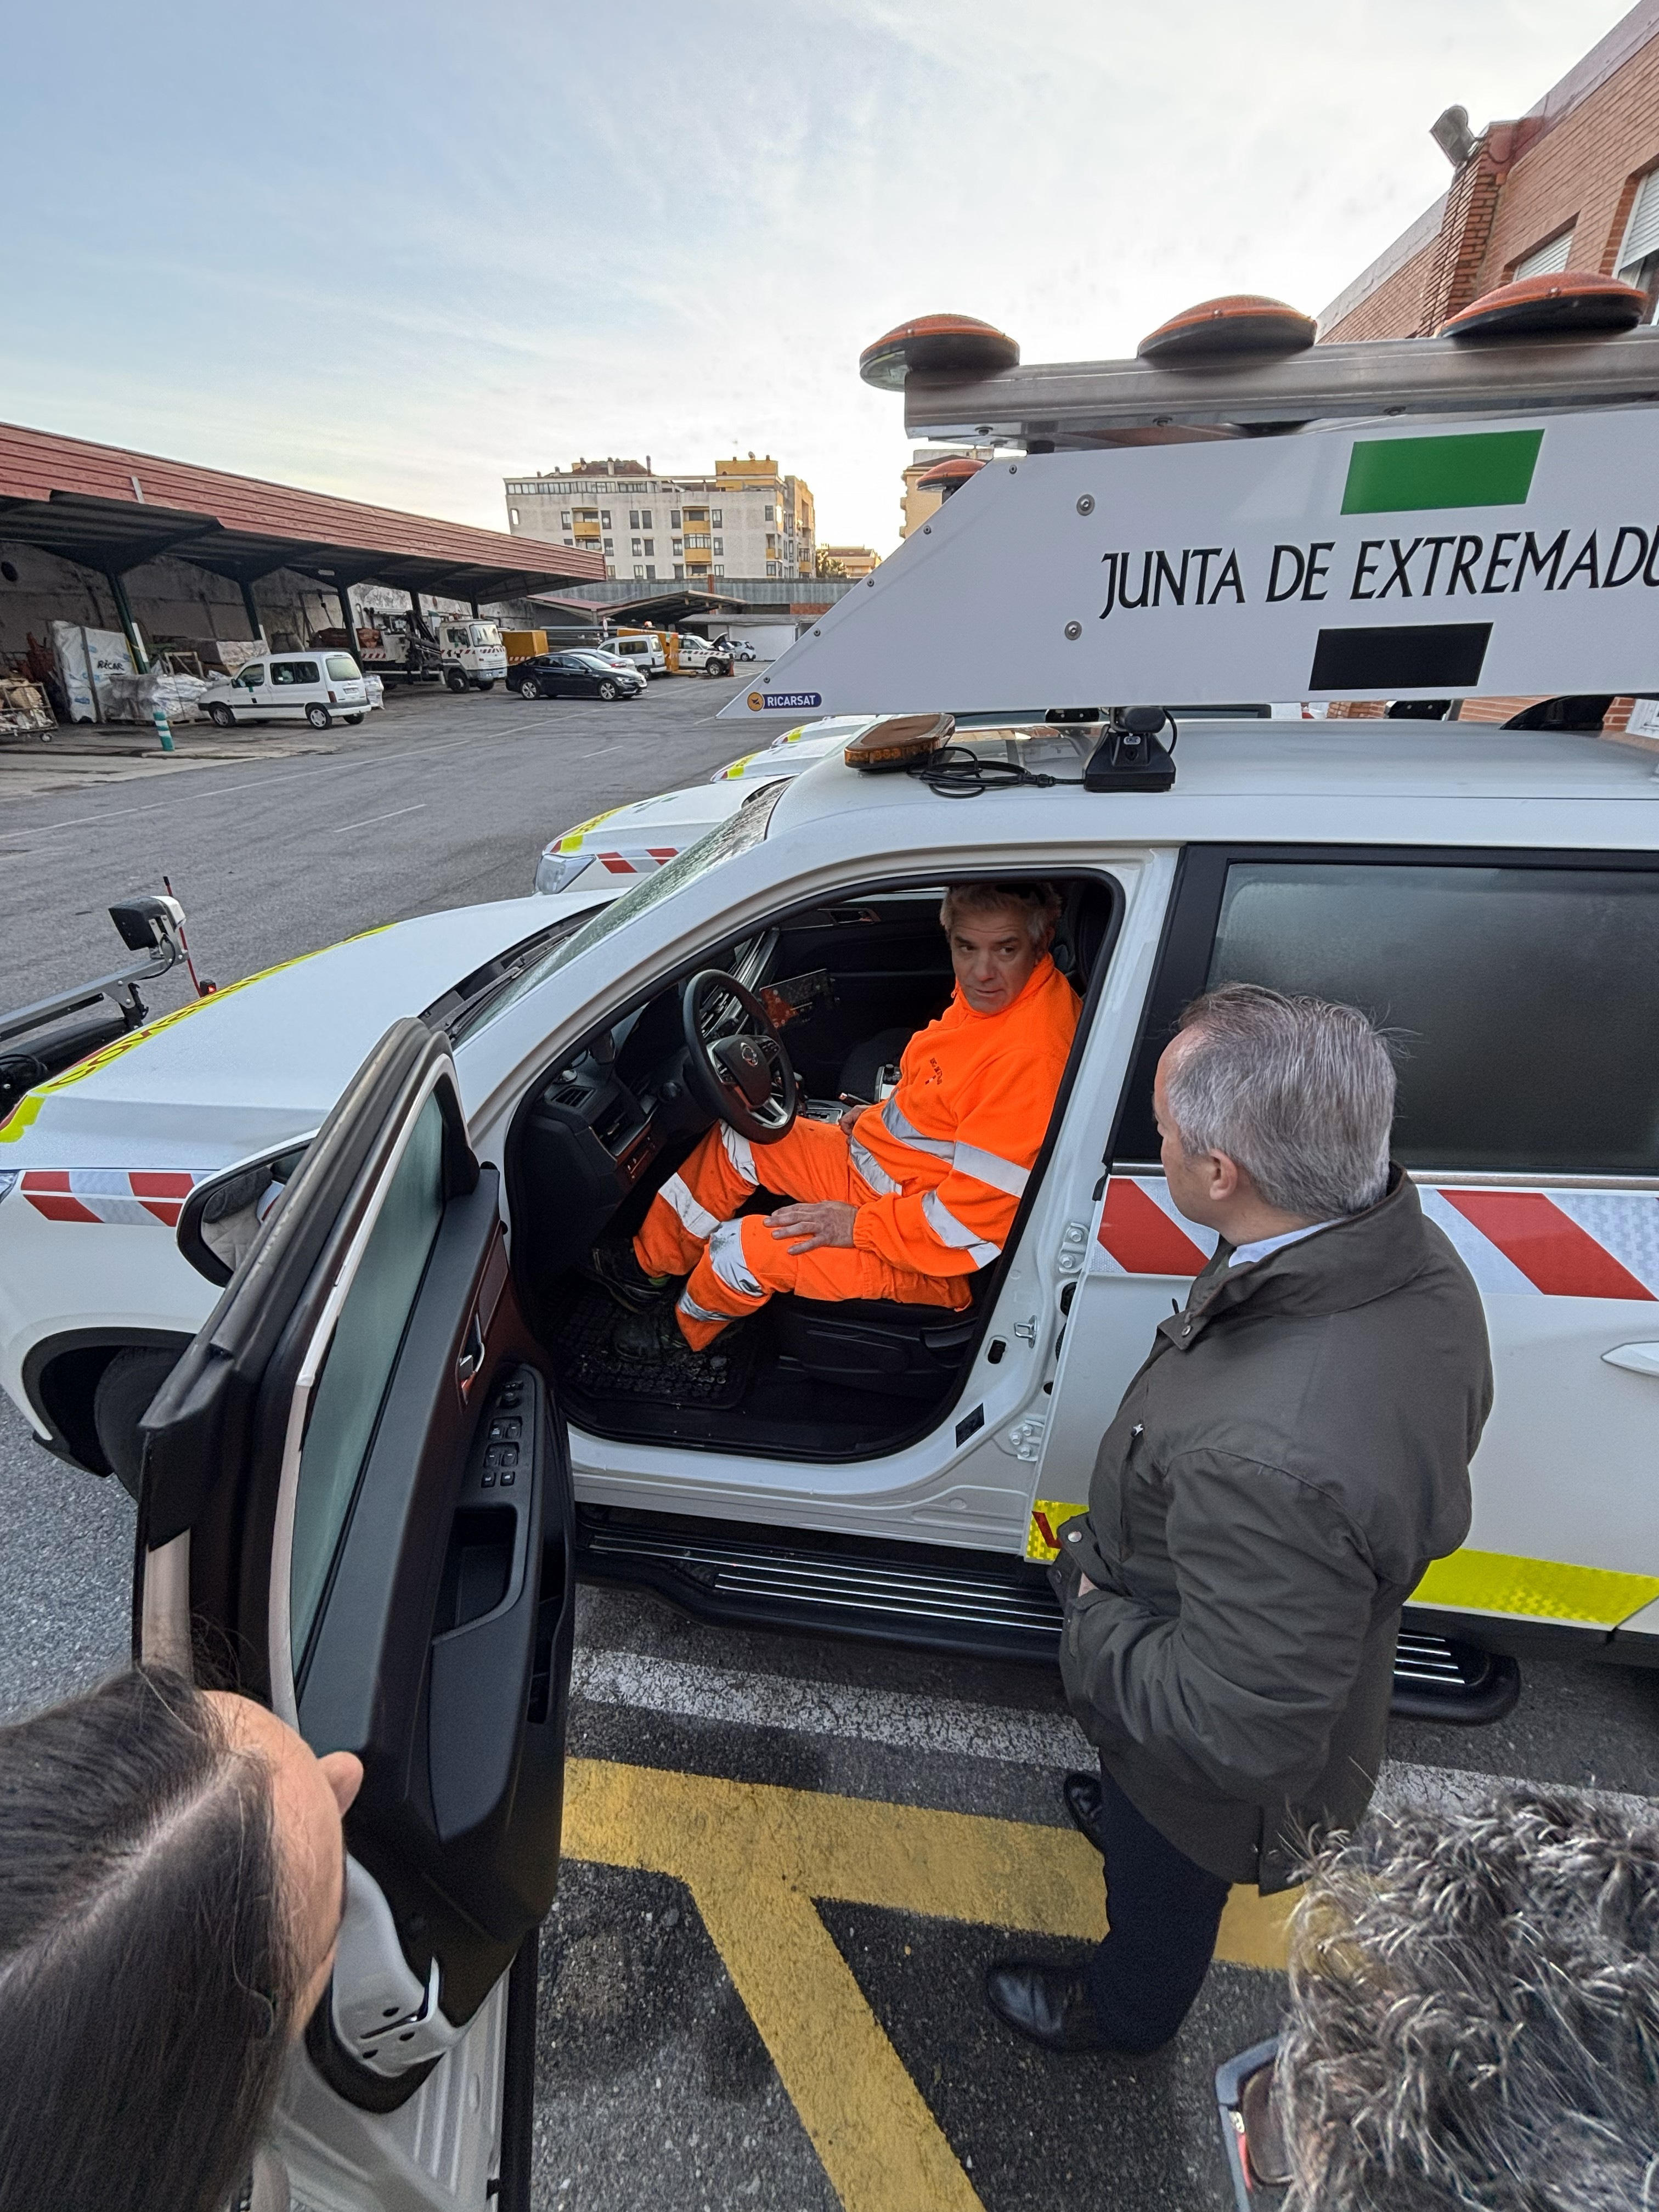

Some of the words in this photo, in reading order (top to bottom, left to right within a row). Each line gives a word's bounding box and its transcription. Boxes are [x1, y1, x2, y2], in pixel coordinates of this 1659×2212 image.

[1098, 548, 1245, 620] JUNTA
[1265, 541, 1336, 602] DE
[767, 695, 816, 707] RICARSAT
